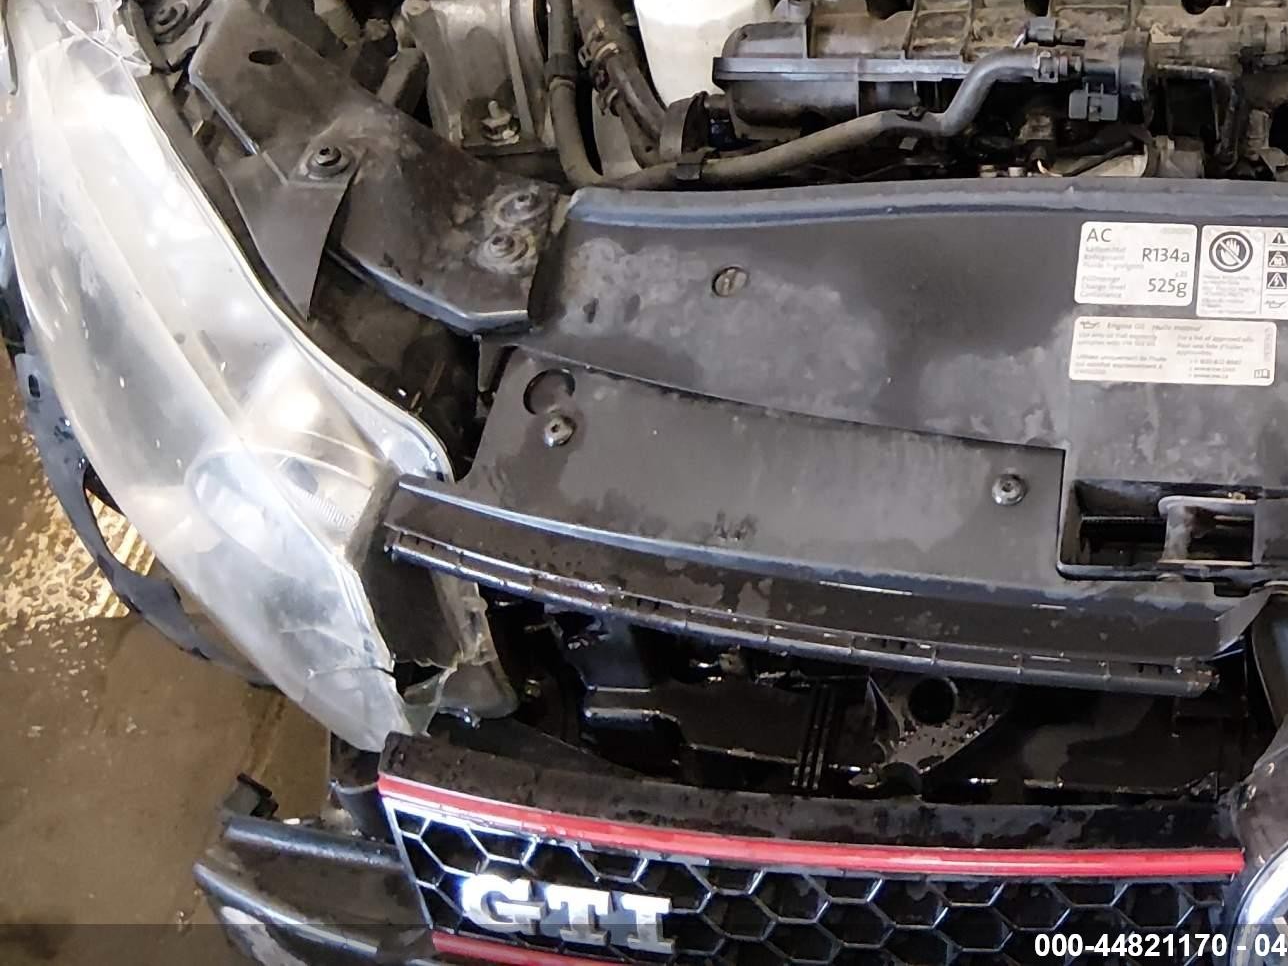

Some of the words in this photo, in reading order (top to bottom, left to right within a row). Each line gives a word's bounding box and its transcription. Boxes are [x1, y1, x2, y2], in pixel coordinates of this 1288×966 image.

[1086, 227, 1112, 242] AC
[1142, 247, 1190, 263] R134a
[1147, 277, 1188, 298] 525g
[461, 874, 677, 955] GTI
